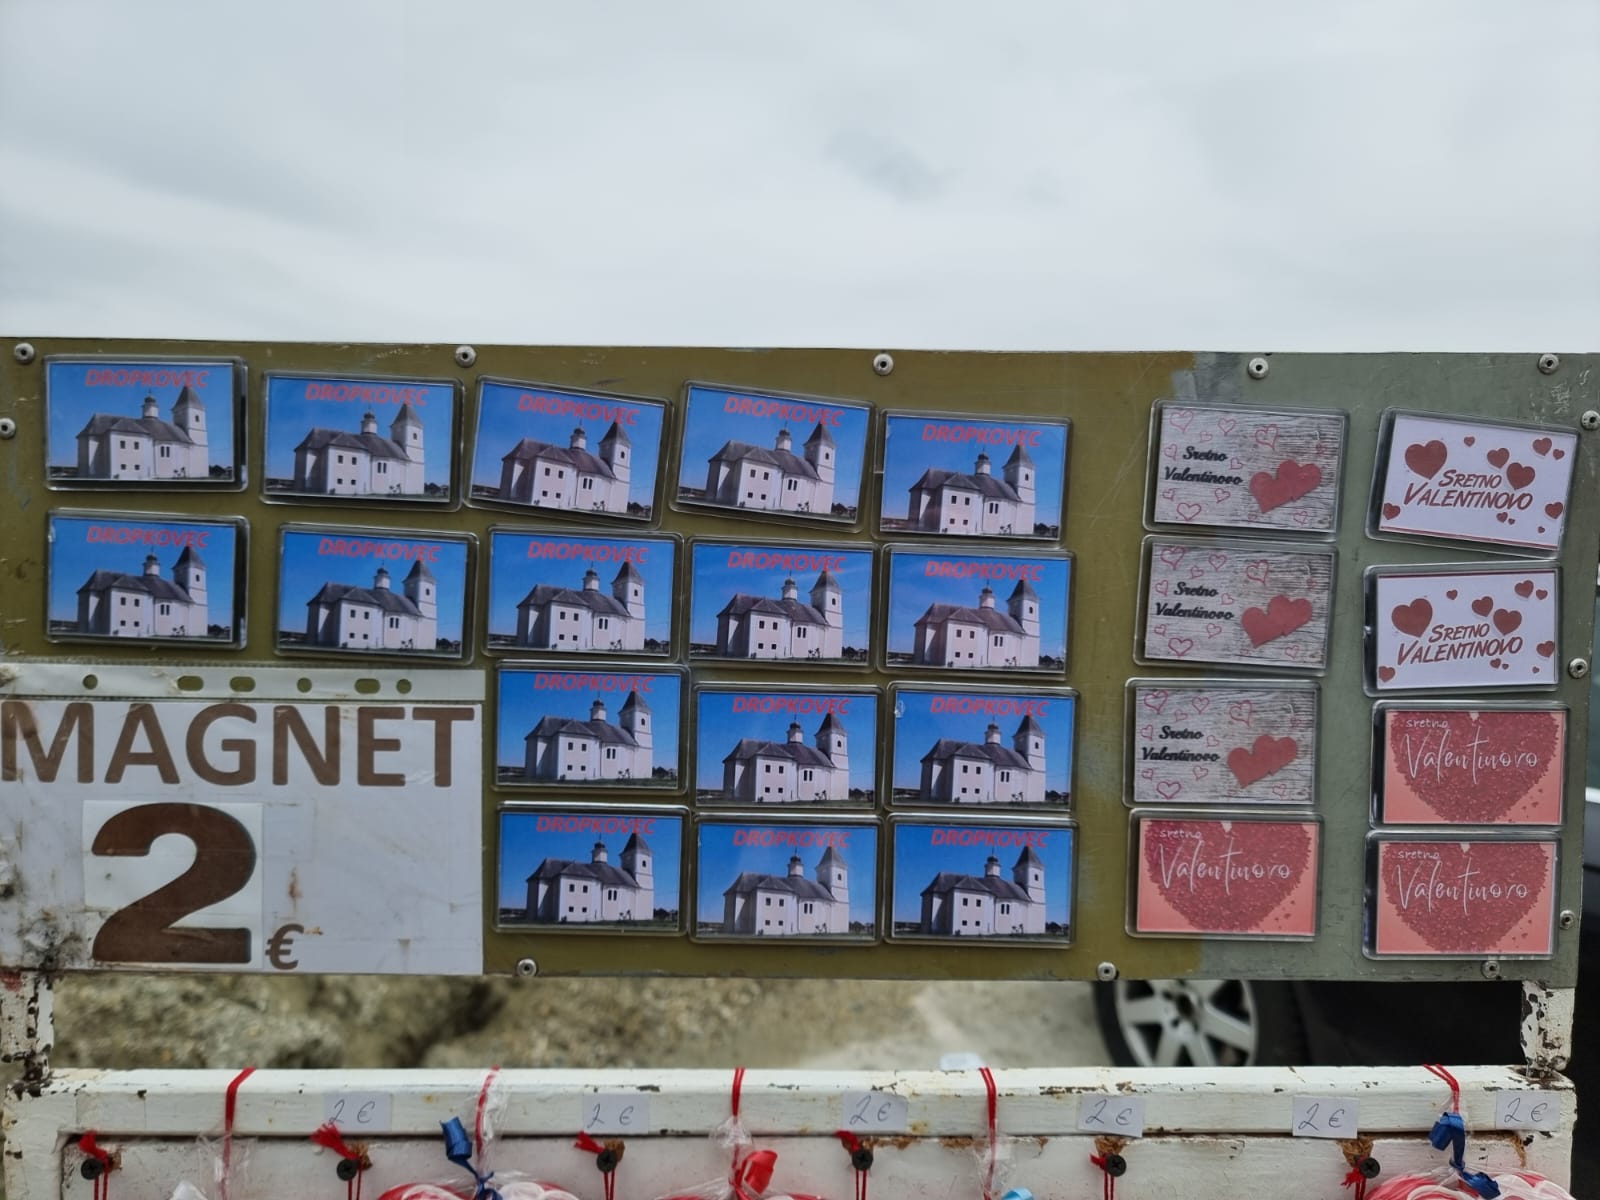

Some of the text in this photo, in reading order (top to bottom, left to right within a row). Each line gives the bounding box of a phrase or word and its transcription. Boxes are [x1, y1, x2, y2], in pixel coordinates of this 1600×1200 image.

[85, 368, 210, 389] DROPKOVEC
[305, 383, 428, 406] DROPKOVEC
[518, 394, 639, 426] DROPKOVEC
[724, 396, 844, 427] DROPKOVEC
[922, 424, 1042, 448] DROPKOVEC
[1183, 446, 1228, 463] Sretno
[1164, 466, 1242, 486] Valentinovo
[87, 525, 211, 548] DROPKOVEC
[318, 538, 441, 562] DROPKOVEC
[528, 540, 648, 564] DROPKOVEC
[728, 551, 847, 573] DROPKOVEC
[924, 560, 1044, 582] DROPKOVEC
[1174, 582, 1218, 599] Sretno
[1155, 602, 1234, 621] Valentinovo
[533, 673, 654, 693] DROPKOVEC
[732, 697, 851, 715] DROPKOVEC
[930, 697, 1050, 717] DROPKOVEC
[1159, 726, 1204, 742] Sretno
[1406, 718, 1449, 729] sretno
[1, 701, 475, 788] MAGNET
[1141, 747, 1220, 764] Valentinovo
[536, 816, 655, 835] DROPKOVEC
[1159, 829, 1202, 840] sretno
[733, 829, 851, 848] DROPKOVEC
[930, 829, 1049, 848] DROPKOVEC
[1398, 849, 1440, 860] sretno
[91, 802, 305, 970] 2 €
[330, 1098, 346, 1124] 2
[589, 1103, 605, 1128] 2
[849, 1096, 870, 1123] 2
[1086, 1099, 1108, 1126] 2
[1301, 1103, 1318, 1131] 2
[1504, 1097, 1522, 1124] 2
